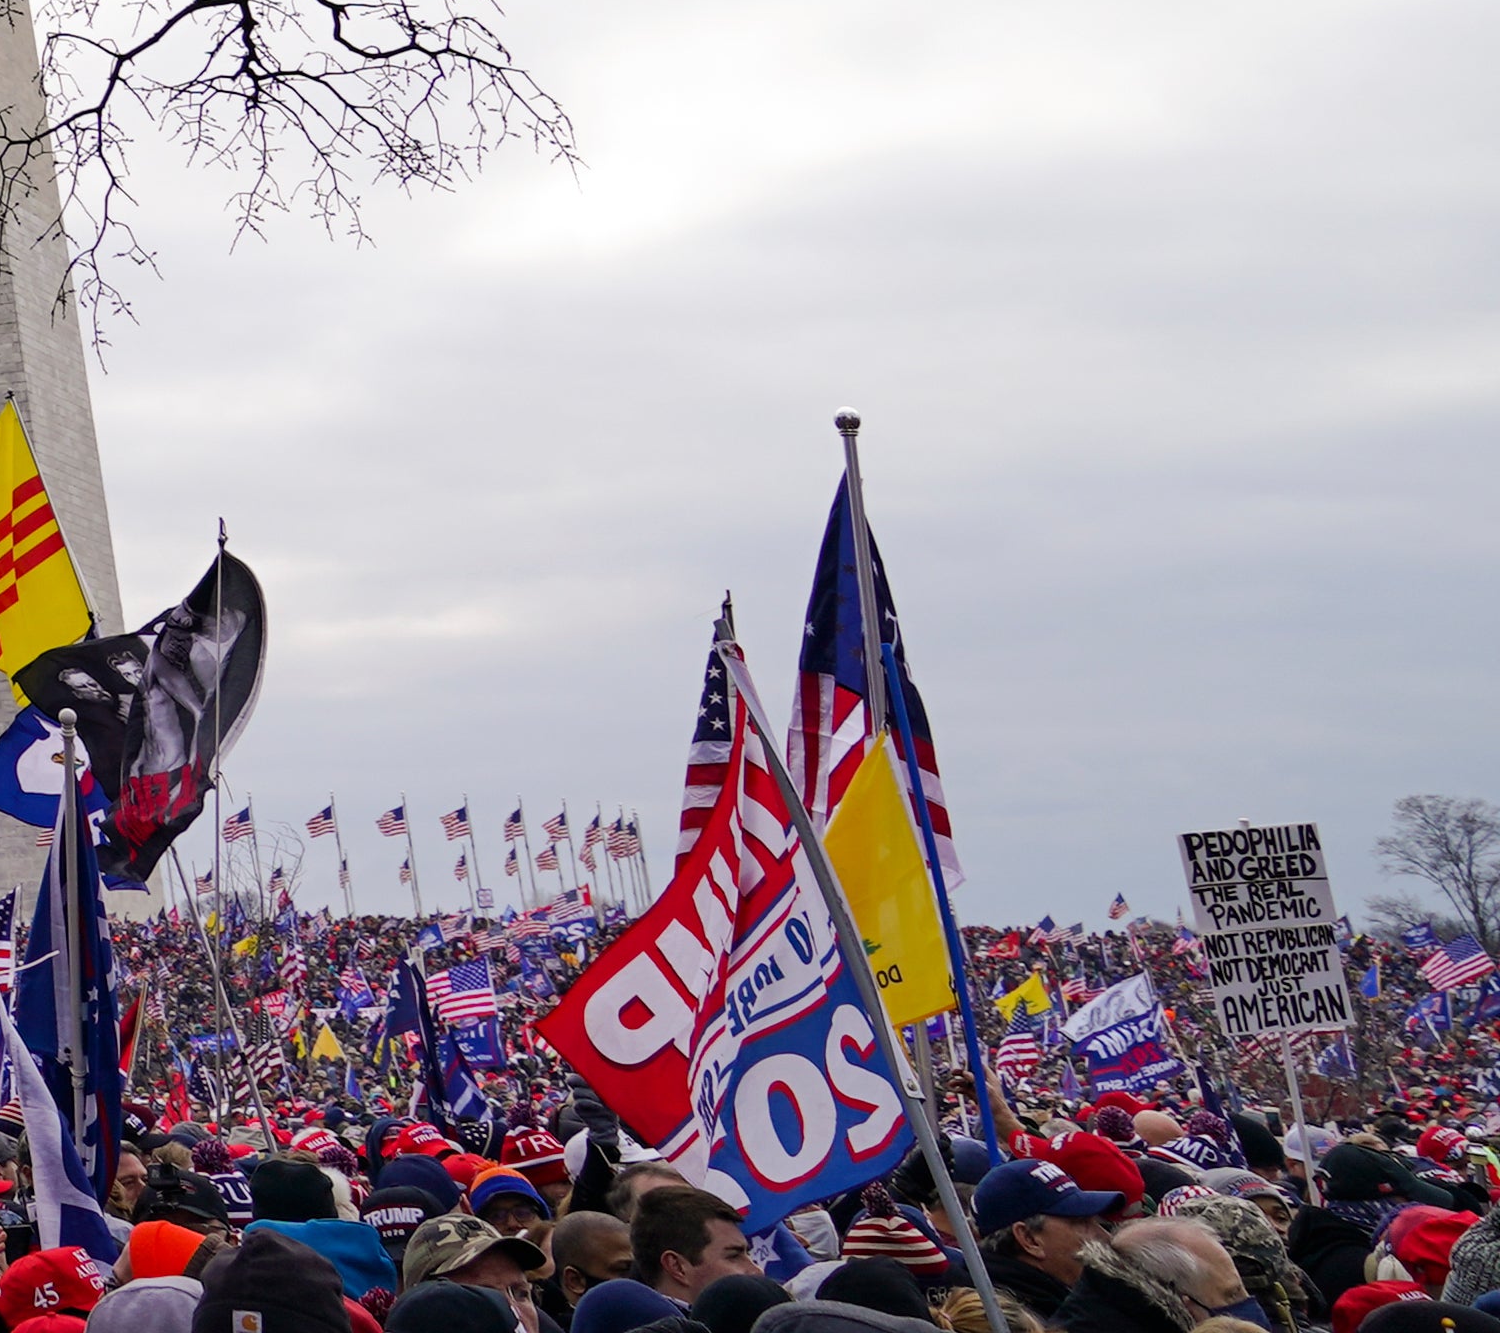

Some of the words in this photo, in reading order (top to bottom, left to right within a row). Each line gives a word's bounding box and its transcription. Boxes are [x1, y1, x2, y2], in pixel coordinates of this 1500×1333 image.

[1182, 824, 1321, 861] PEDOPHILIA
[1192, 858, 1236, 884] AND
[1237, 853, 1317, 881] GREED
[1192, 885, 1239, 907] THE
[1246, 881, 1305, 902] REAL
[1206, 896, 1322, 931] PANDEMIC
[1204, 933, 1240, 960] NOT
[1242, 924, 1338, 956] REPUBLICAN
[1208, 958, 1243, 988] NOT
[1243, 949, 1330, 984] DEMOCRAT
[1257, 975, 1305, 997] JUST
[1222, 984, 1348, 1034] AMERICAN
[363, 1206, 425, 1227] TRUMP
[33, 1282, 60, 1307] 45
